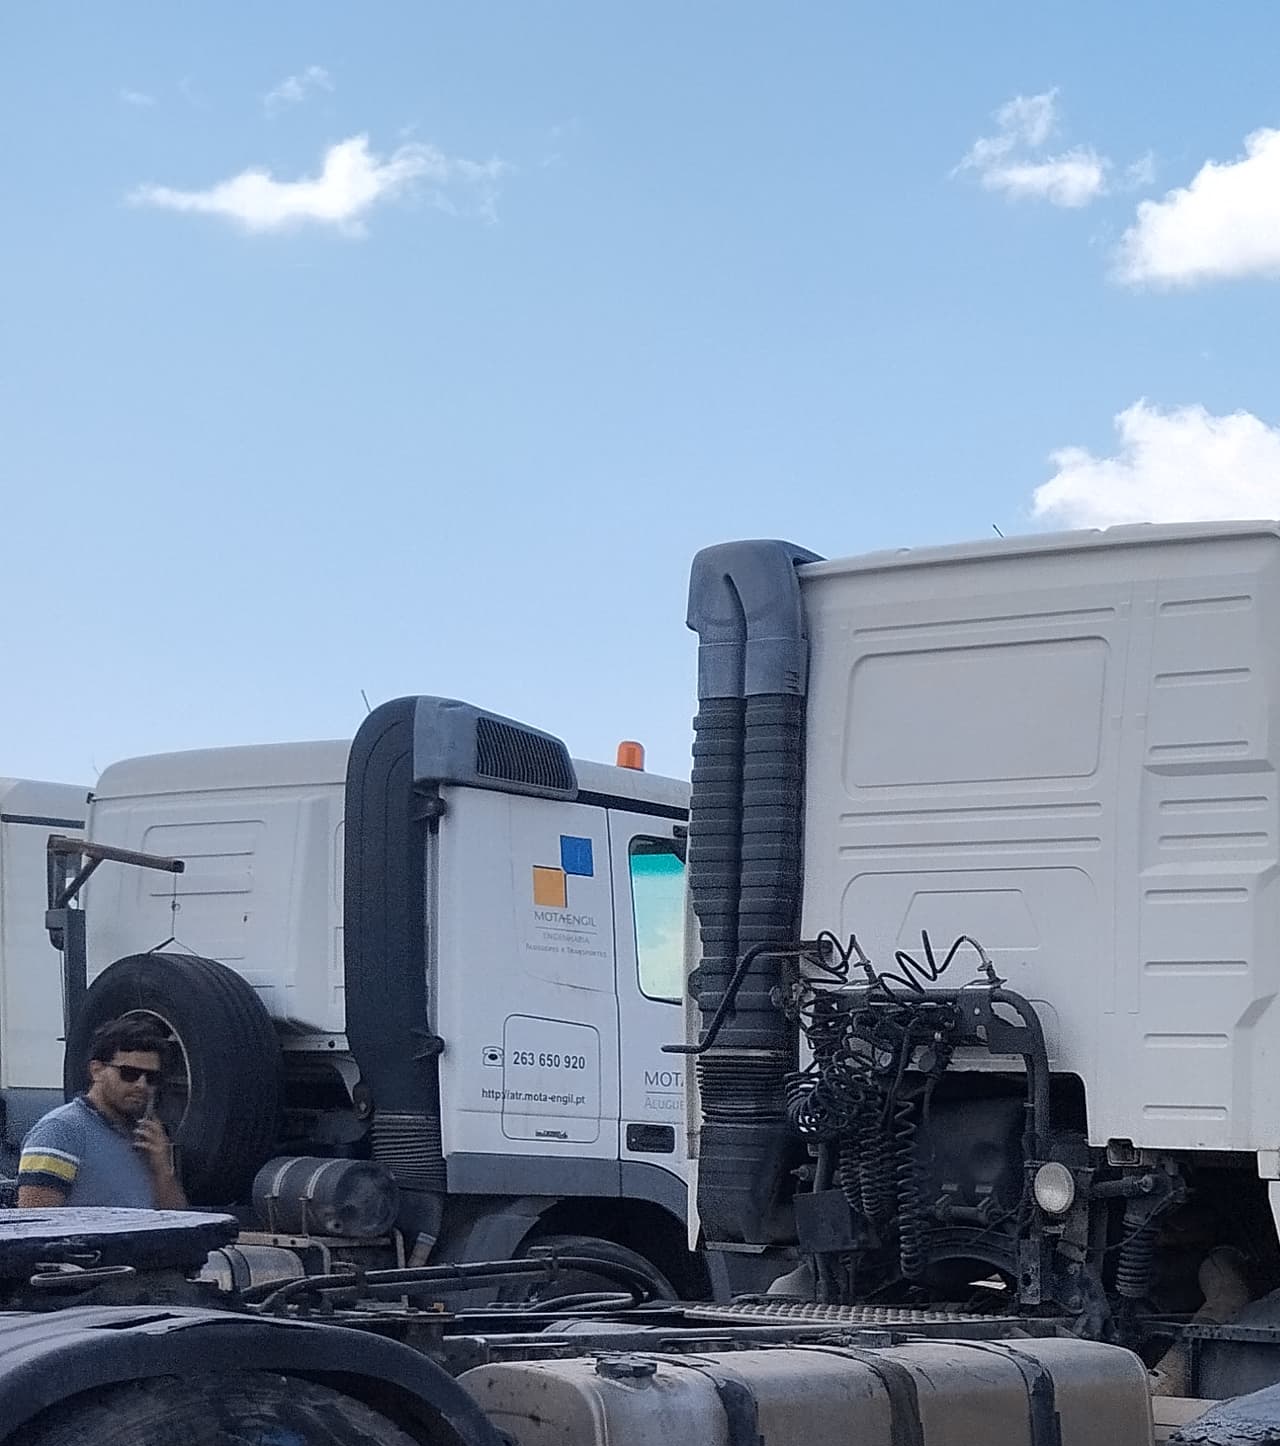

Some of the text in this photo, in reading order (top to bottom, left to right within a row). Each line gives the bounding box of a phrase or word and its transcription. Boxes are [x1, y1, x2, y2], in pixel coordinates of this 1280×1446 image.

[512, 1050, 586, 1070] 263 650 920
